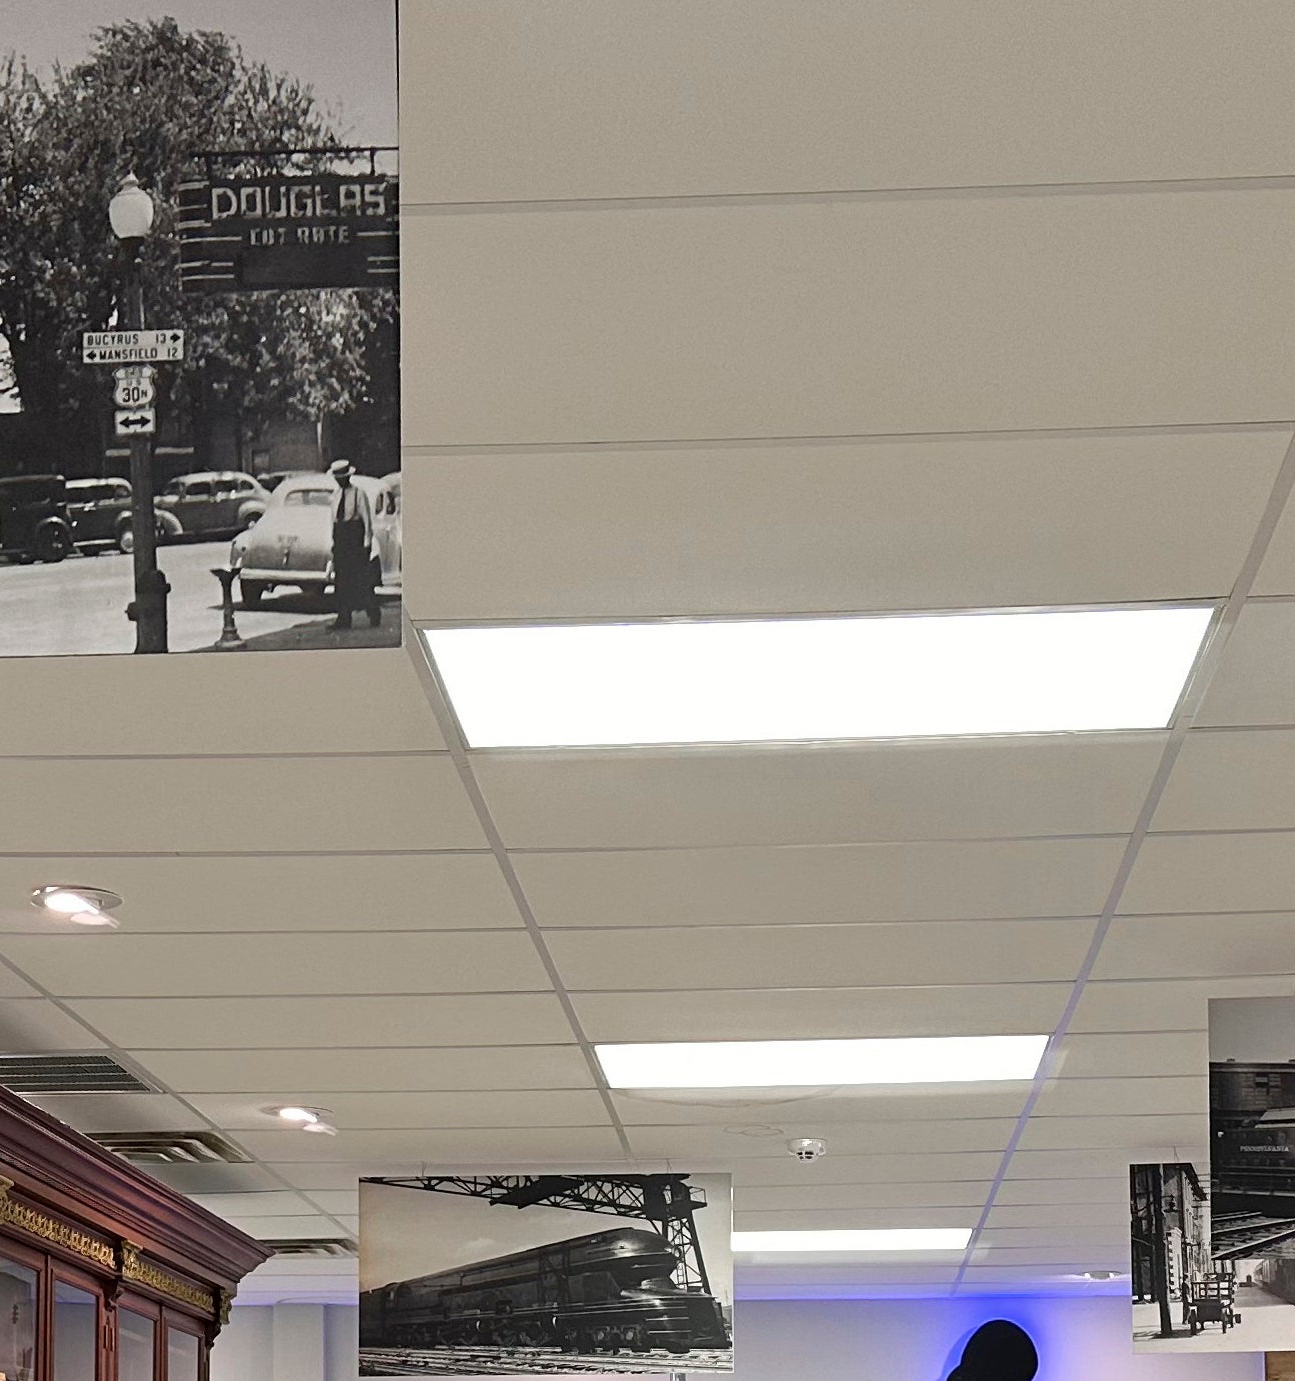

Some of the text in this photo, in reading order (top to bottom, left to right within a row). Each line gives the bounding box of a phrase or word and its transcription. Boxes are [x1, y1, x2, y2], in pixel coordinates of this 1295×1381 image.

[211, 182, 387, 221] DOUGLAS
[250, 225, 351, 246] CUT RATE
[87, 333, 166, 346] BUCYRUS 13
[99, 347, 178, 360] MANSFIELD 12
